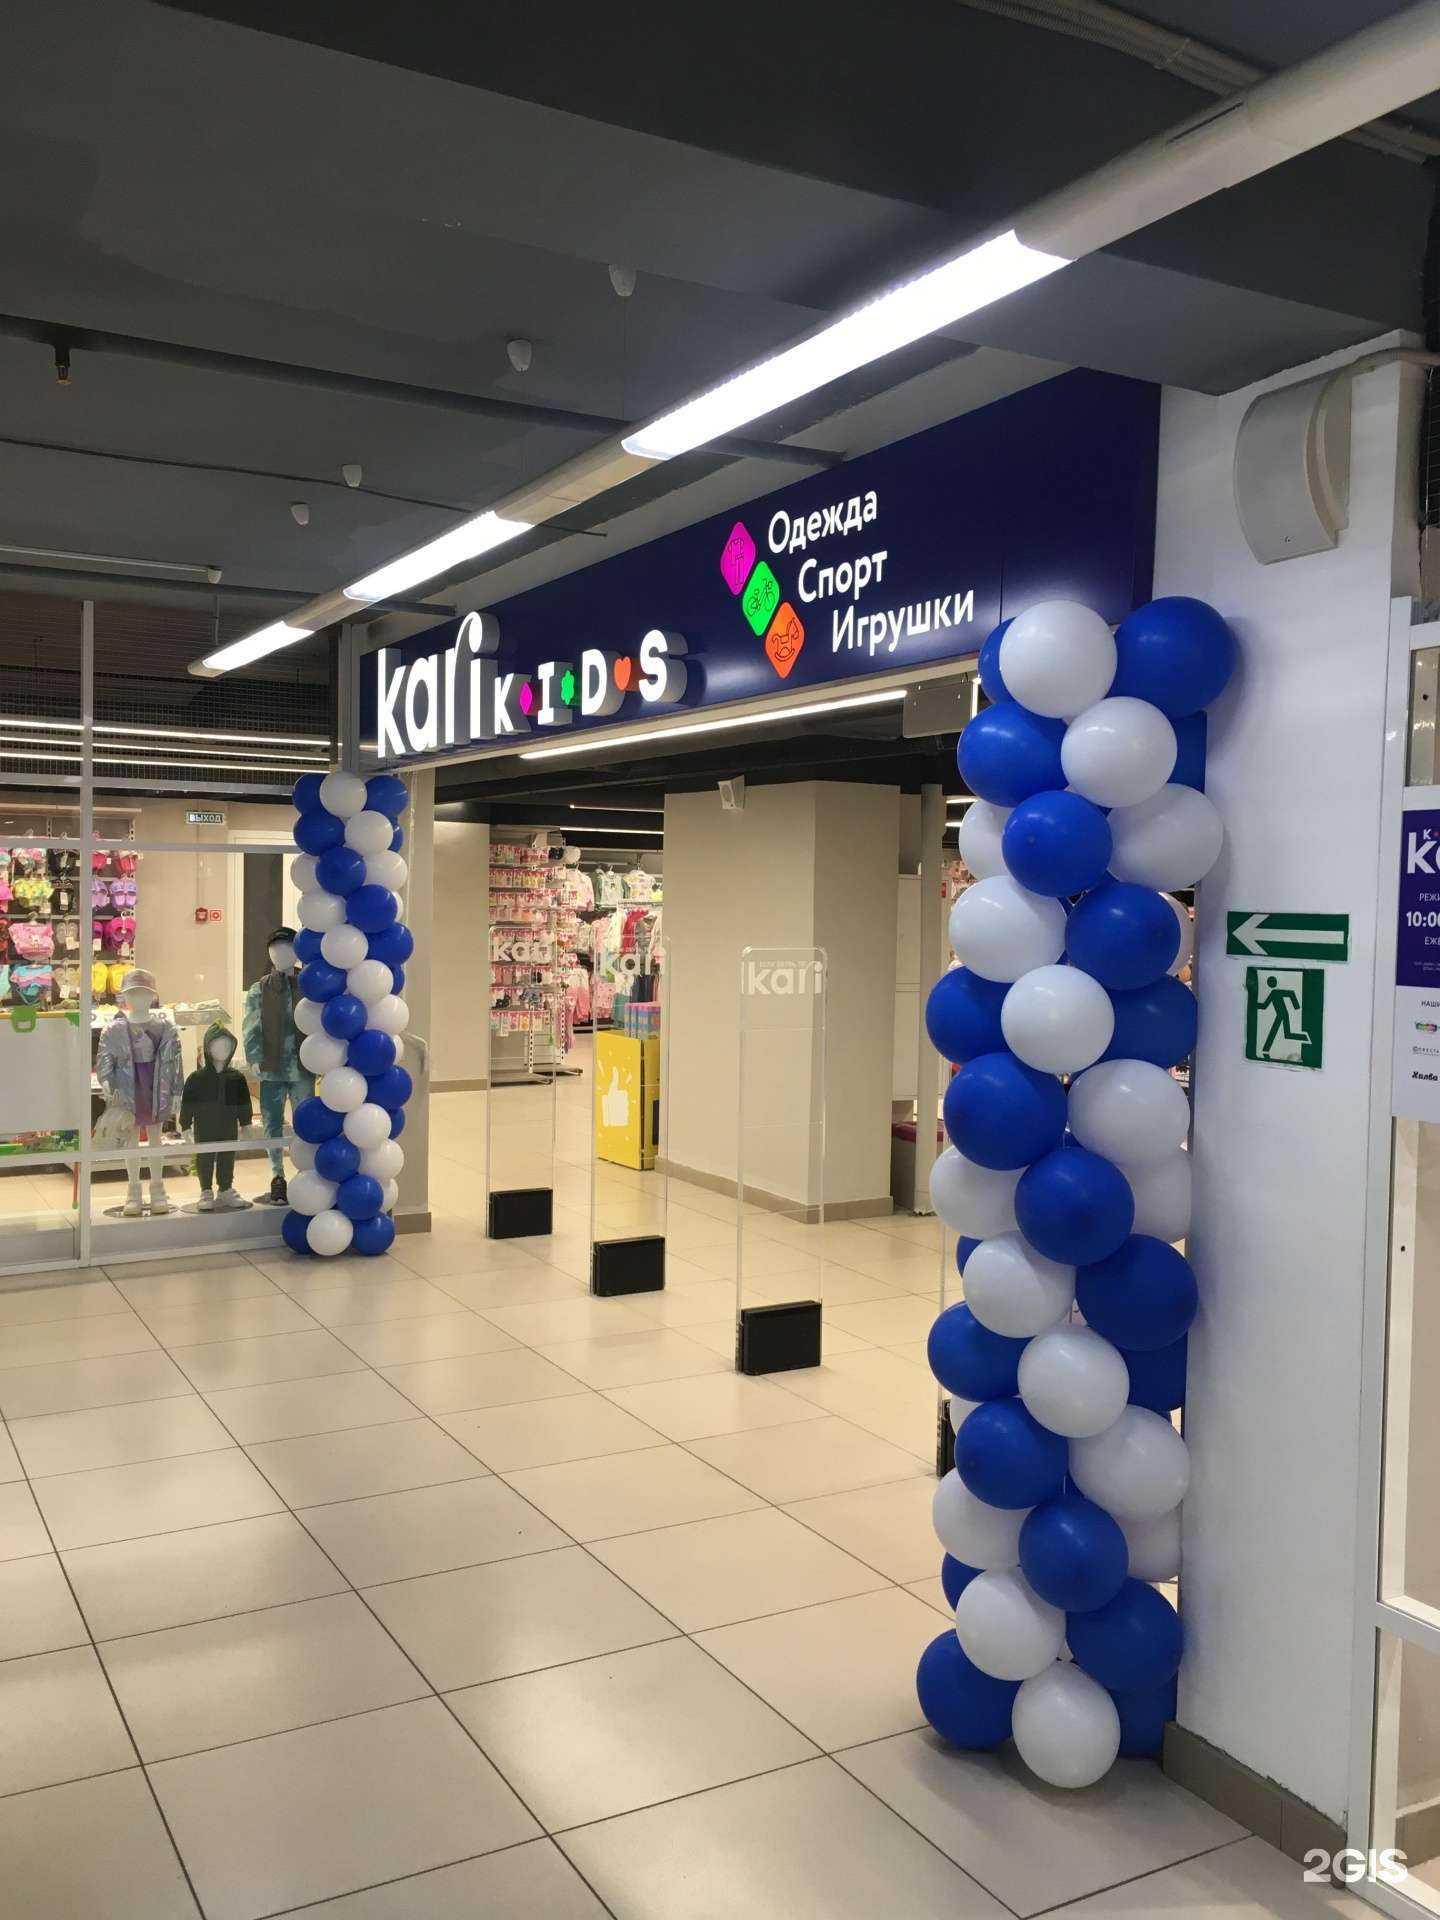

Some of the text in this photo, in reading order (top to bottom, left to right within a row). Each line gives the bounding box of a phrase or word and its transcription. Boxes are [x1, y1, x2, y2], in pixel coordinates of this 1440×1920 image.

[768, 490, 878, 554] Одежда
[798, 550, 888, 603] Спорт
[832, 589, 974, 657] Игрушки
[377, 611, 484, 758] kari
[189, 813, 222, 823] ВЫХОД
[748, 960, 823, 995] kari
